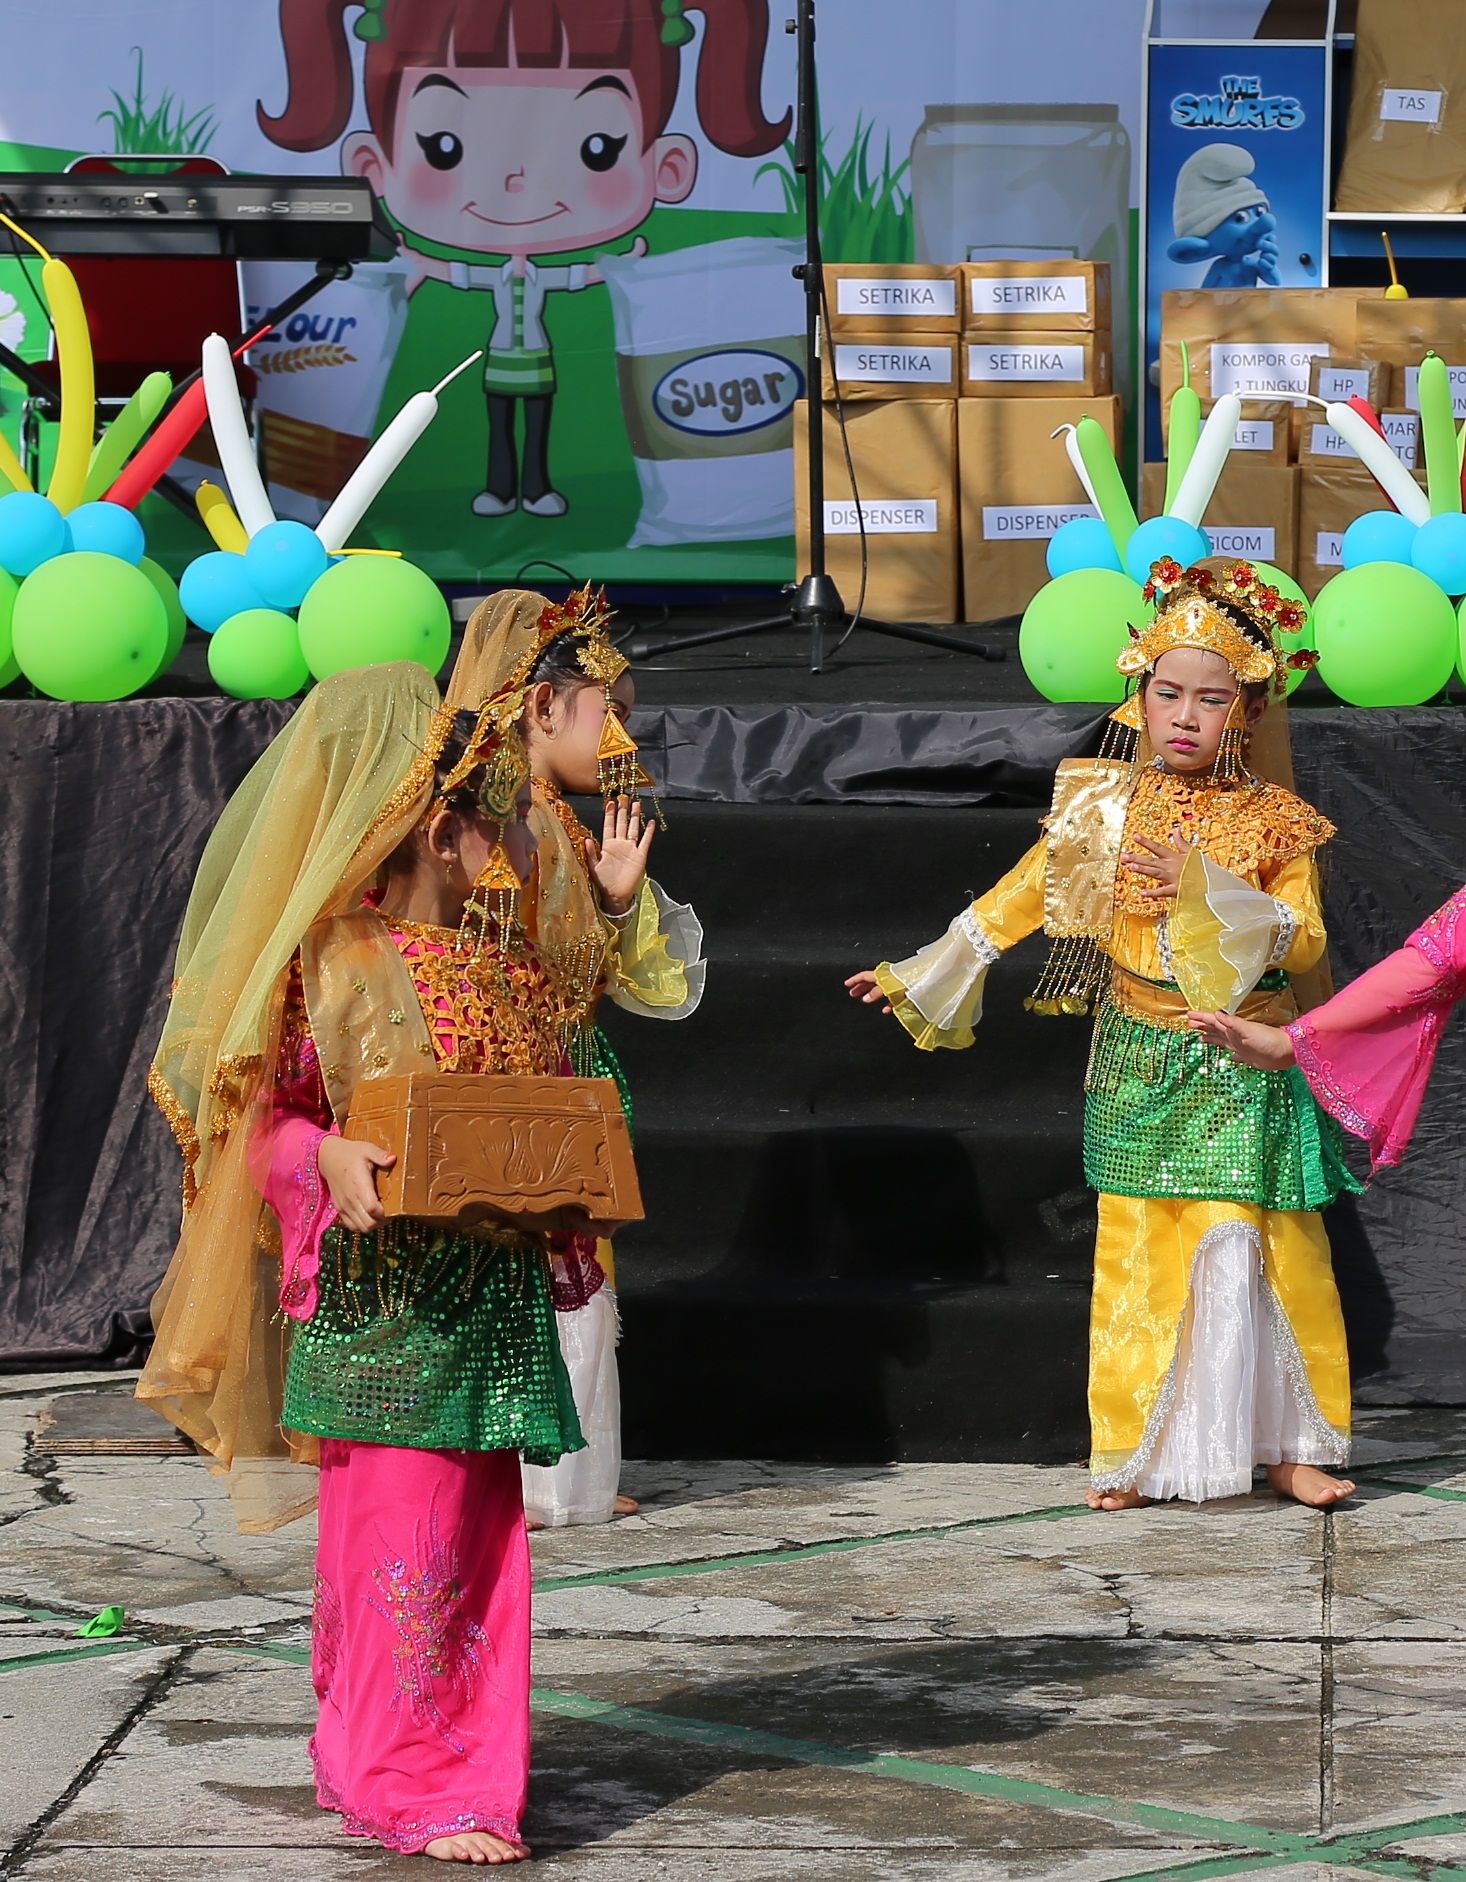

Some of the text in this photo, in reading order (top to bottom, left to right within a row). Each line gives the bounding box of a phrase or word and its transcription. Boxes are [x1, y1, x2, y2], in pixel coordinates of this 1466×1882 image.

[1221, 76, 1260, 99] THE
[1171, 94, 1304, 128] SMURFS
[1398, 96, 1426, 110] TAS
[859, 287, 936, 305] SETRIKA
[992, 285, 1066, 303] SETRIKA
[857, 353, 932, 371] SETRIKA
[989, 354, 1064, 371] SETRIKA
[1222, 353, 1318, 367] KOMPOR GA
[1246, 379, 1307, 392] TUNGKU
[1333, 379, 1354, 392] HP
[670, 371, 785, 423] Sugar
[830, 508, 926, 526] DISPENSER
